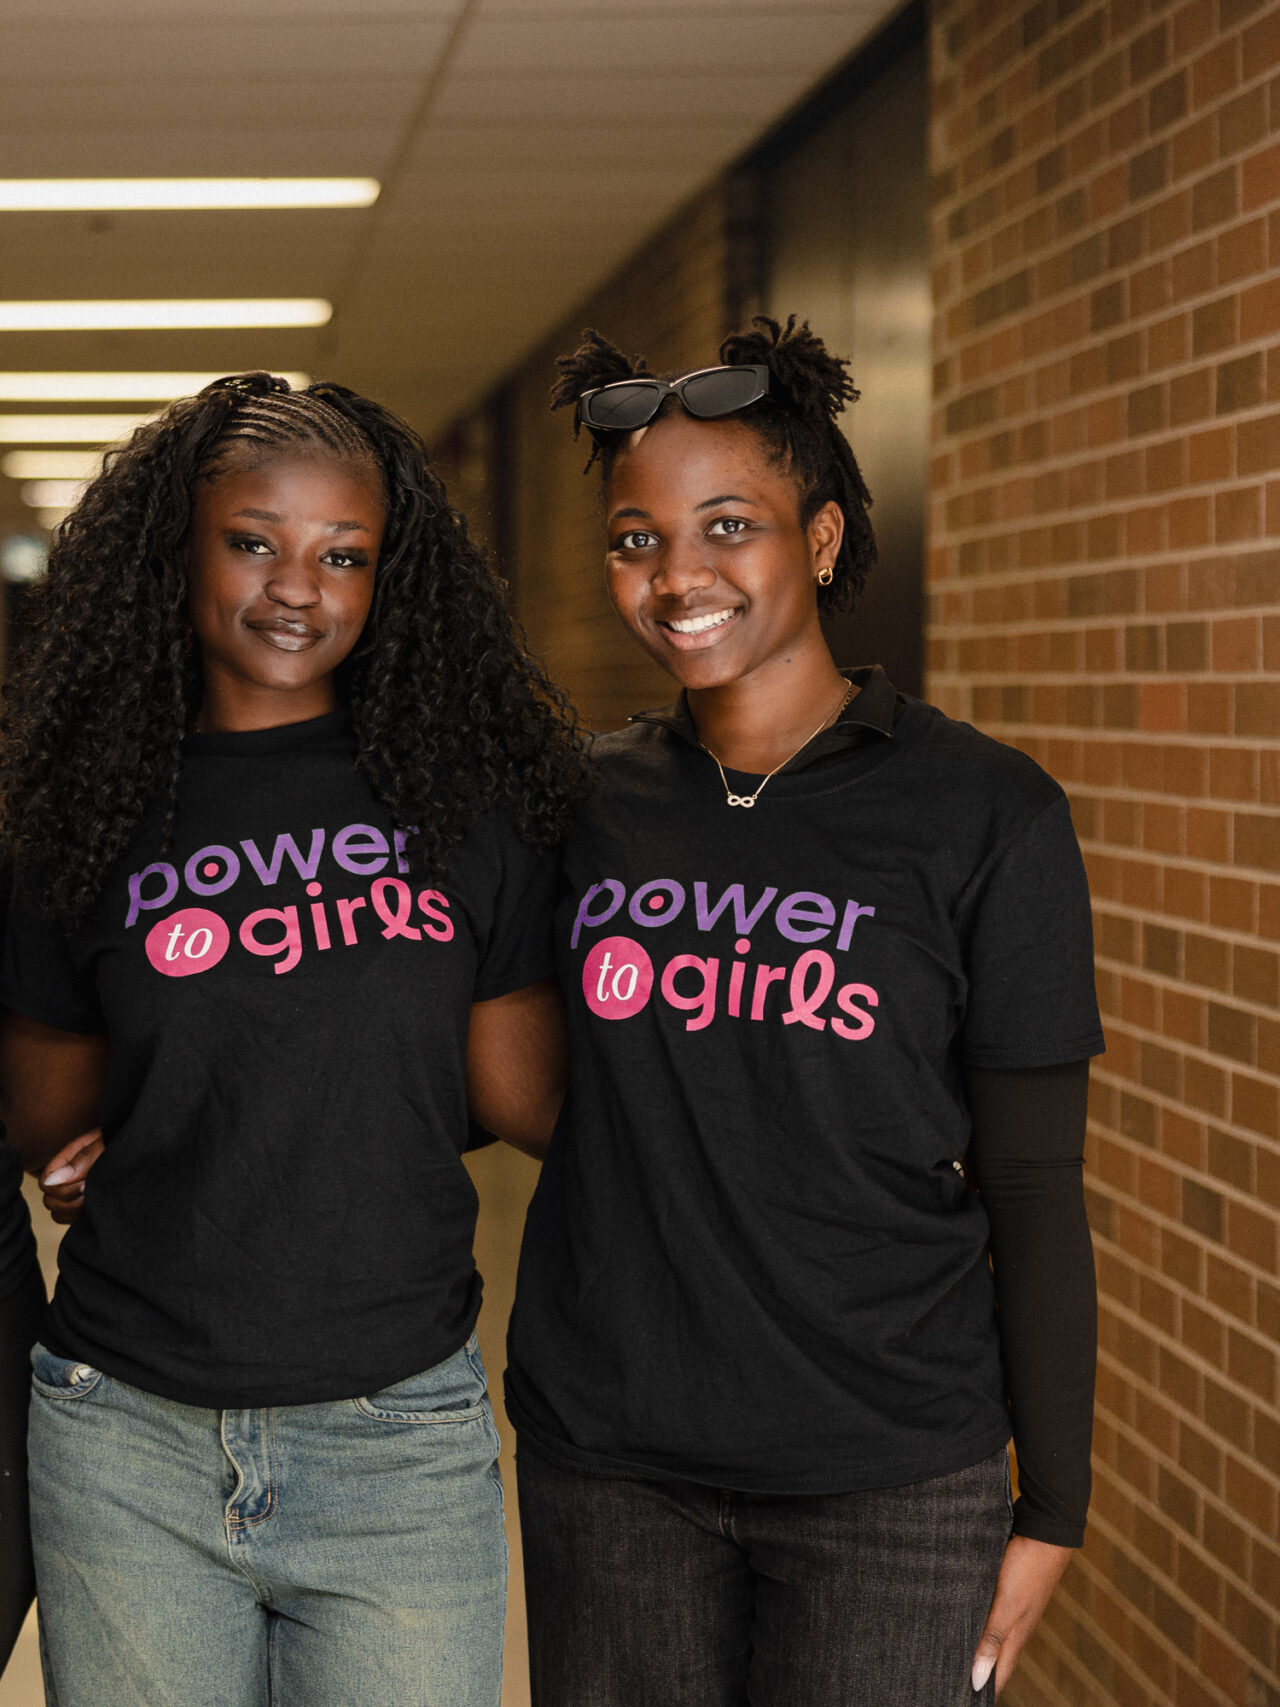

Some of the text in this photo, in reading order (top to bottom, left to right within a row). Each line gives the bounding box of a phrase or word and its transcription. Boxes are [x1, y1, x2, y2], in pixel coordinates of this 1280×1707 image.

[125, 823, 419, 929] power
[164, 877, 455, 975] to girls
[571, 878, 876, 951] power
[596, 938, 879, 1041] to girls
